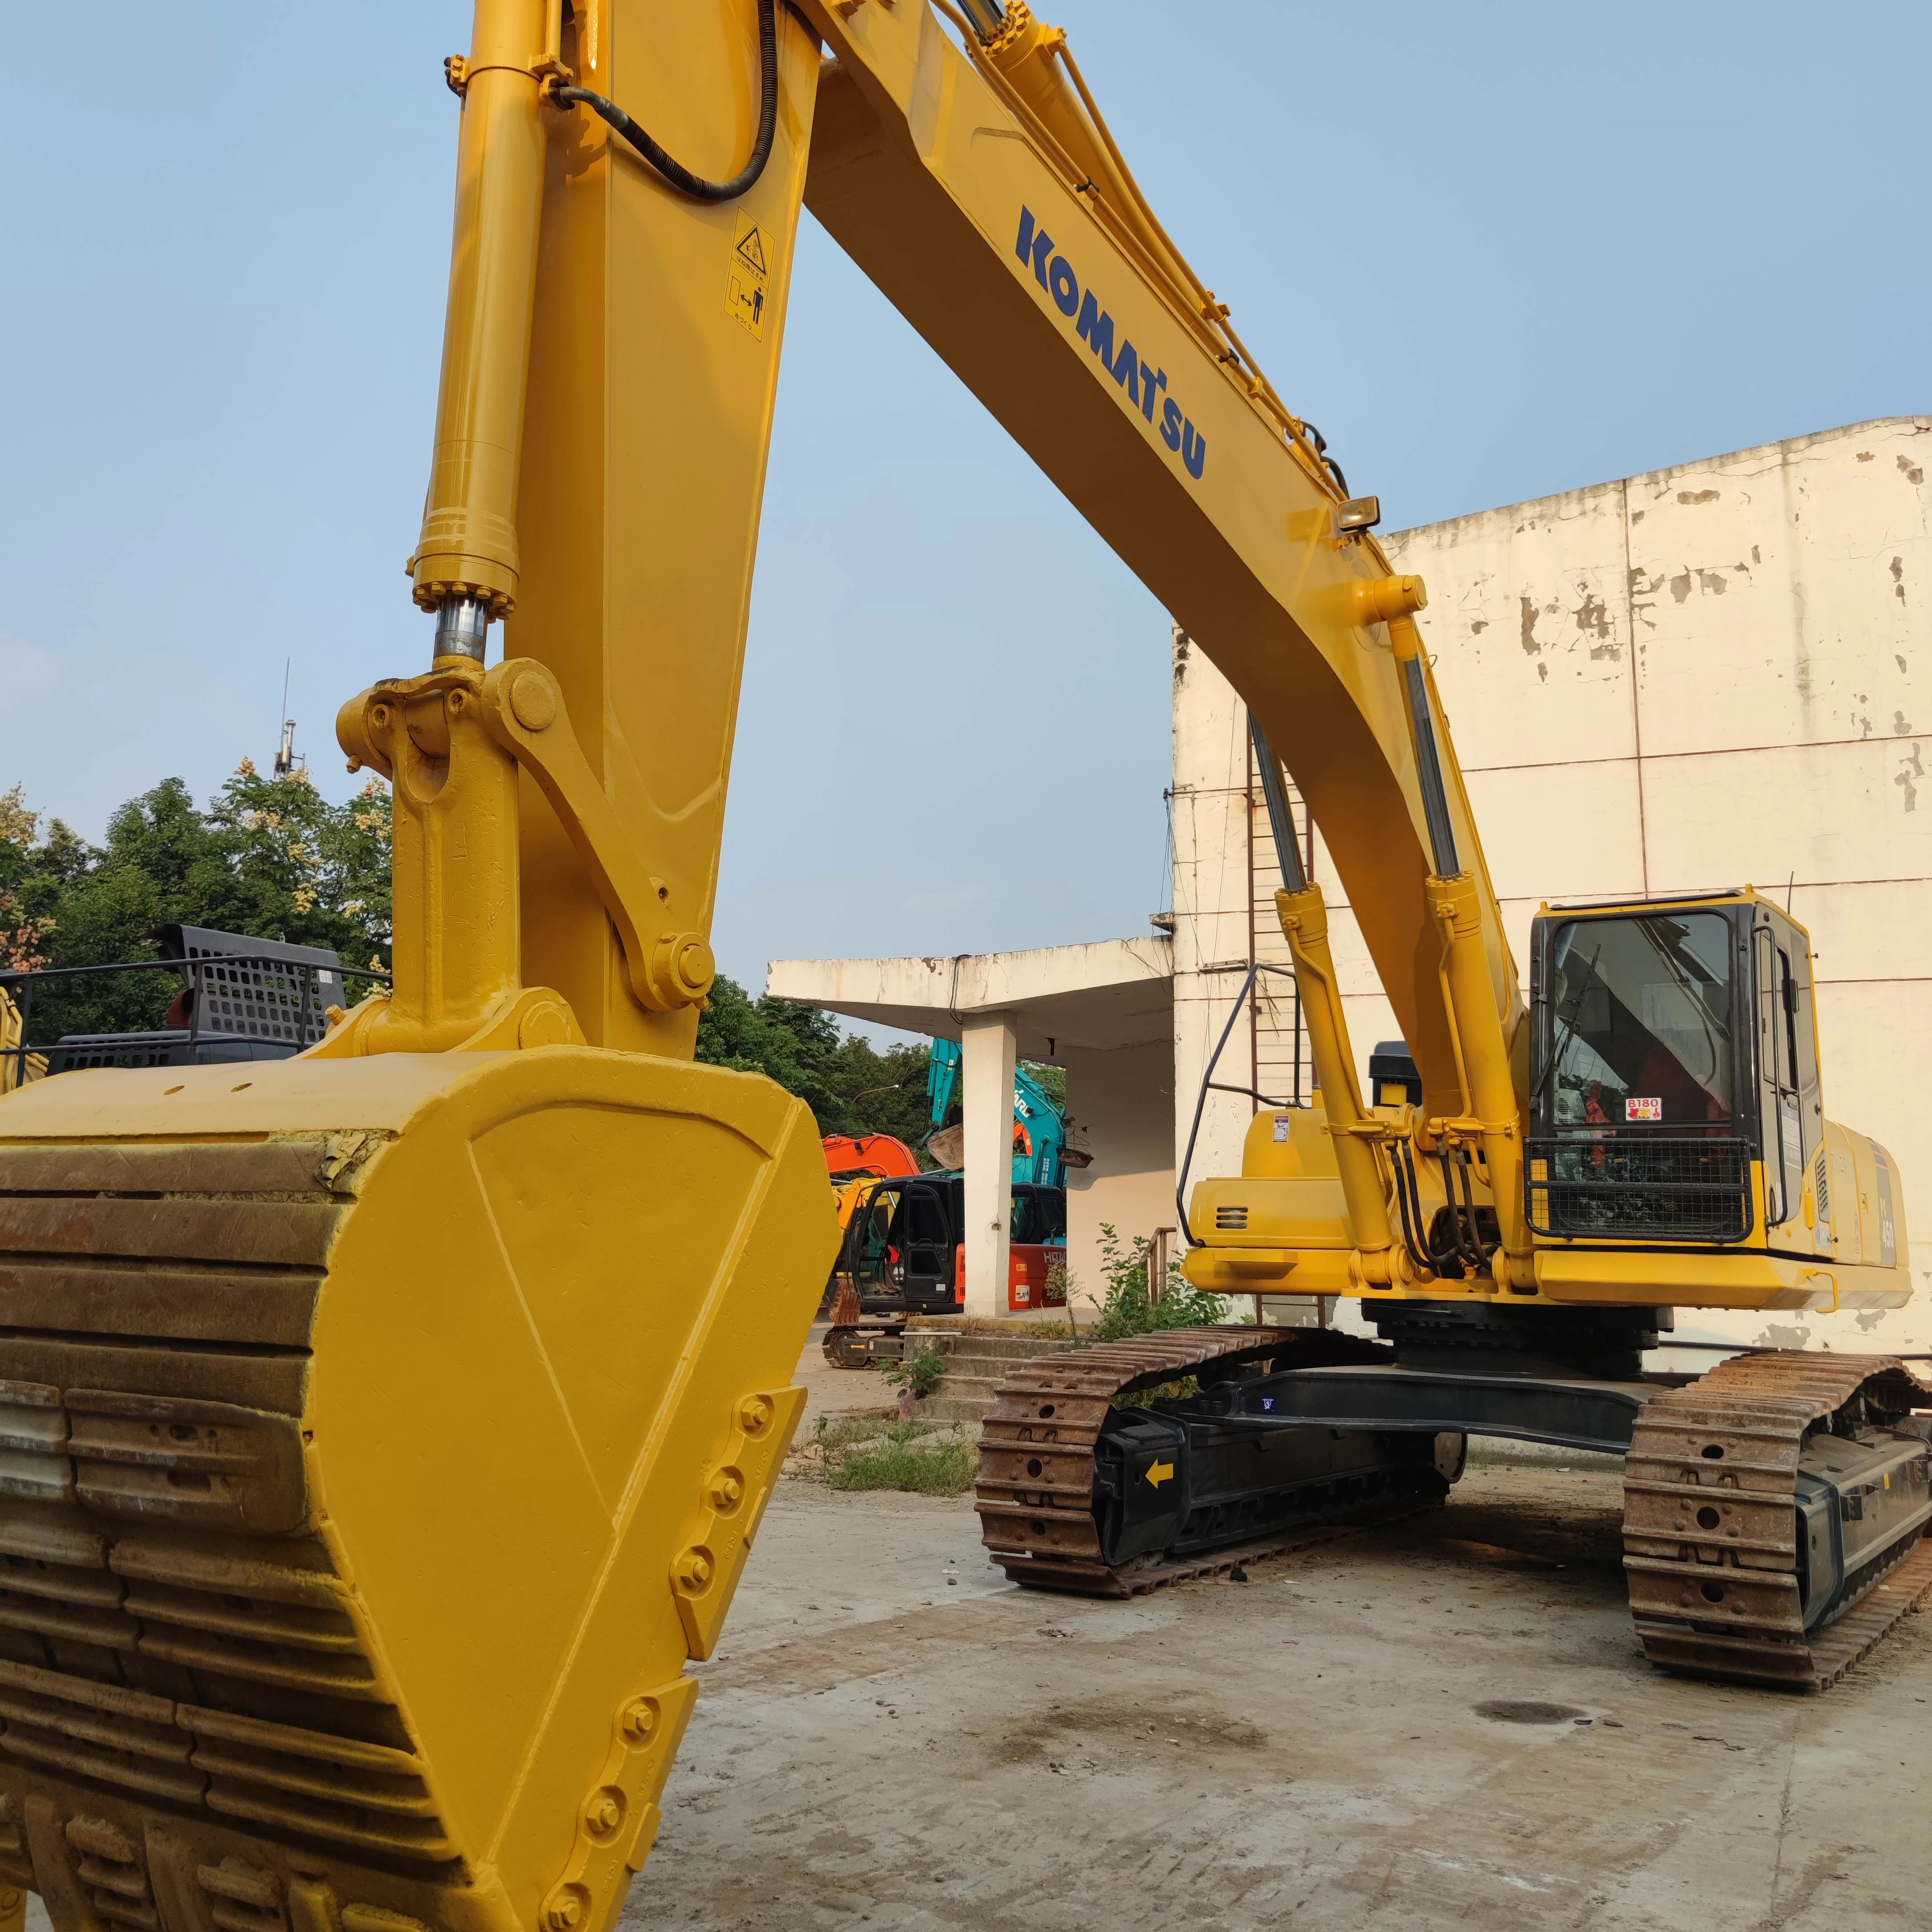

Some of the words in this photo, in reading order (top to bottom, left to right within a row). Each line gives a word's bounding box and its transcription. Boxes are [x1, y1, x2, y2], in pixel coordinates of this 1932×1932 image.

[737, 255, 764, 283] はね飛ばされ
[734, 312, 752, 331] 近づくな
[1015, 204, 1206, 480] KOMATSU
[1628, 1099, 1658, 1107] B180
[1882, 1220, 1894, 1249] 450
